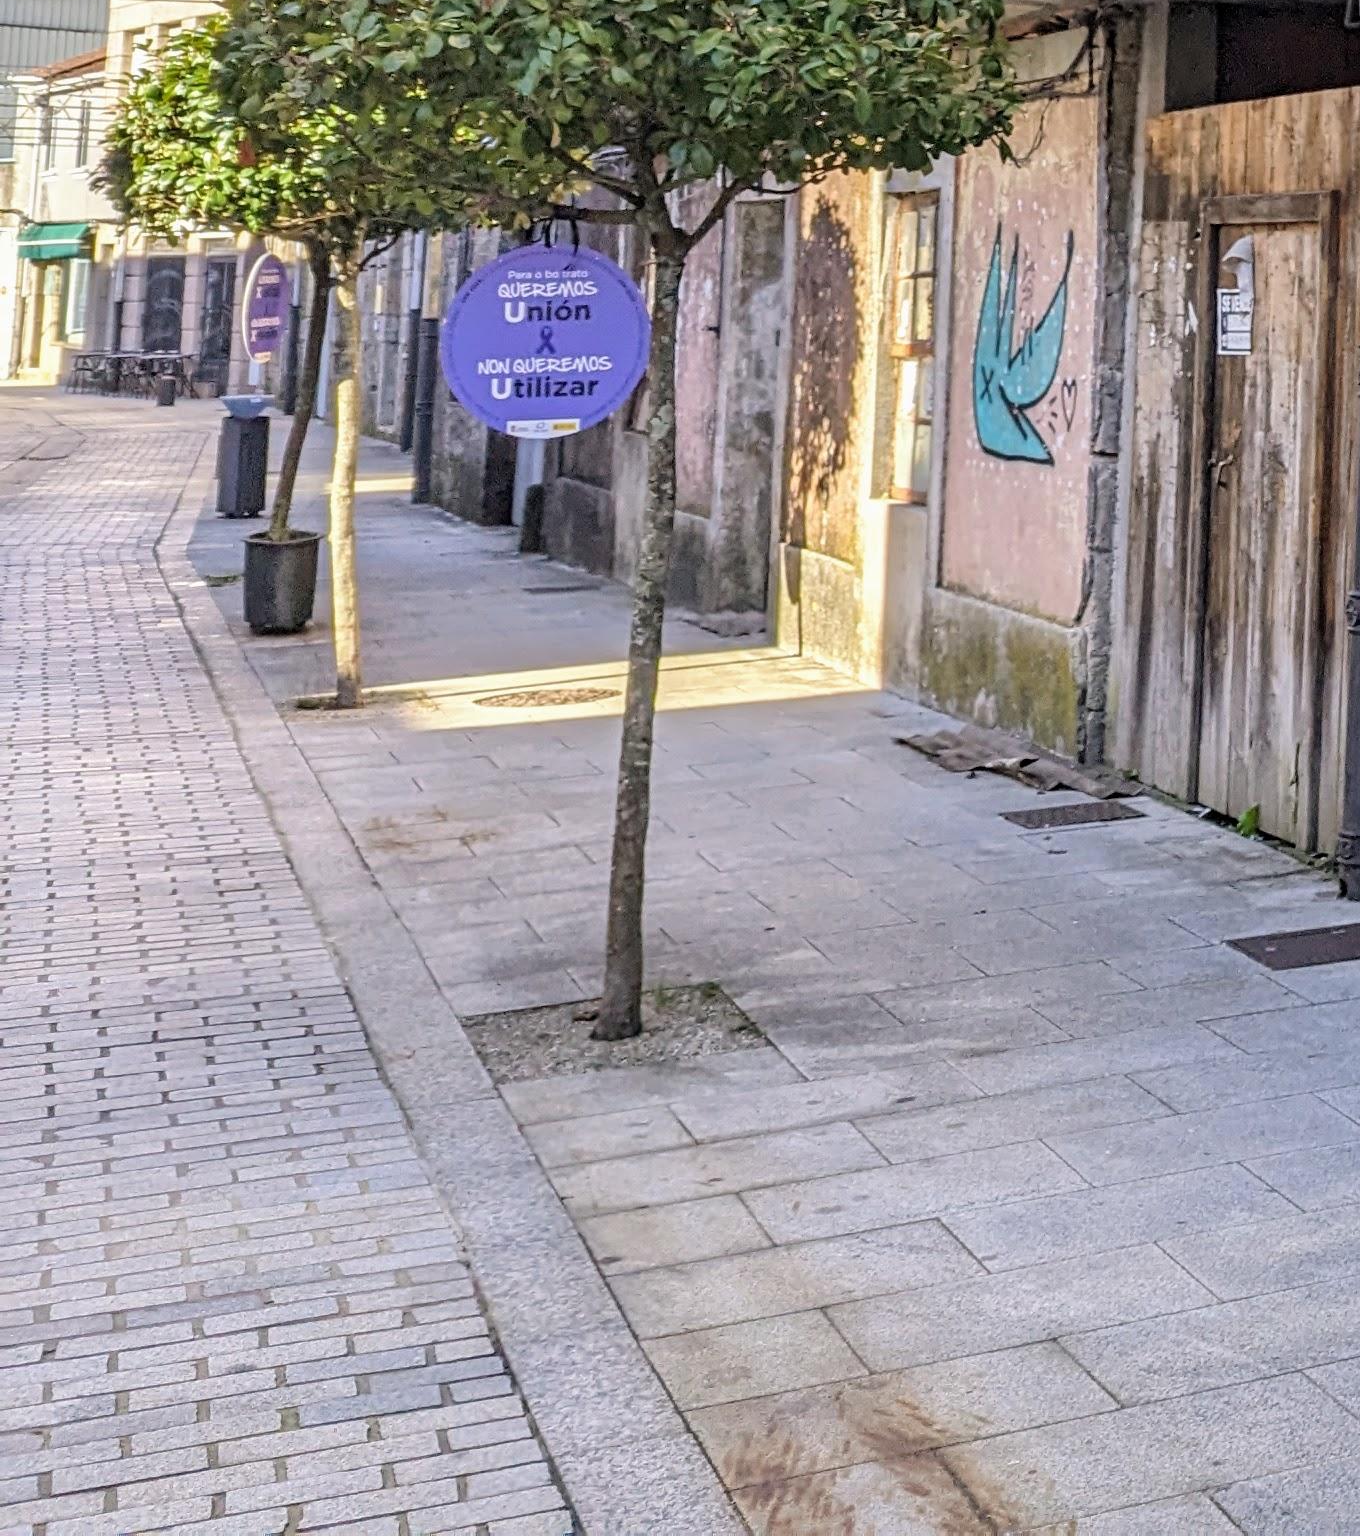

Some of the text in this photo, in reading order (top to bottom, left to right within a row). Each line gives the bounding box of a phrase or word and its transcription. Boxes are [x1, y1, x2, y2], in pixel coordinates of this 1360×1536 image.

[497, 281, 598, 298] QUEREMOS
[504, 299, 591, 323] Unión
[477, 355, 613, 375] NON QUEREMOS
[491, 376, 599, 400] Utilizar
